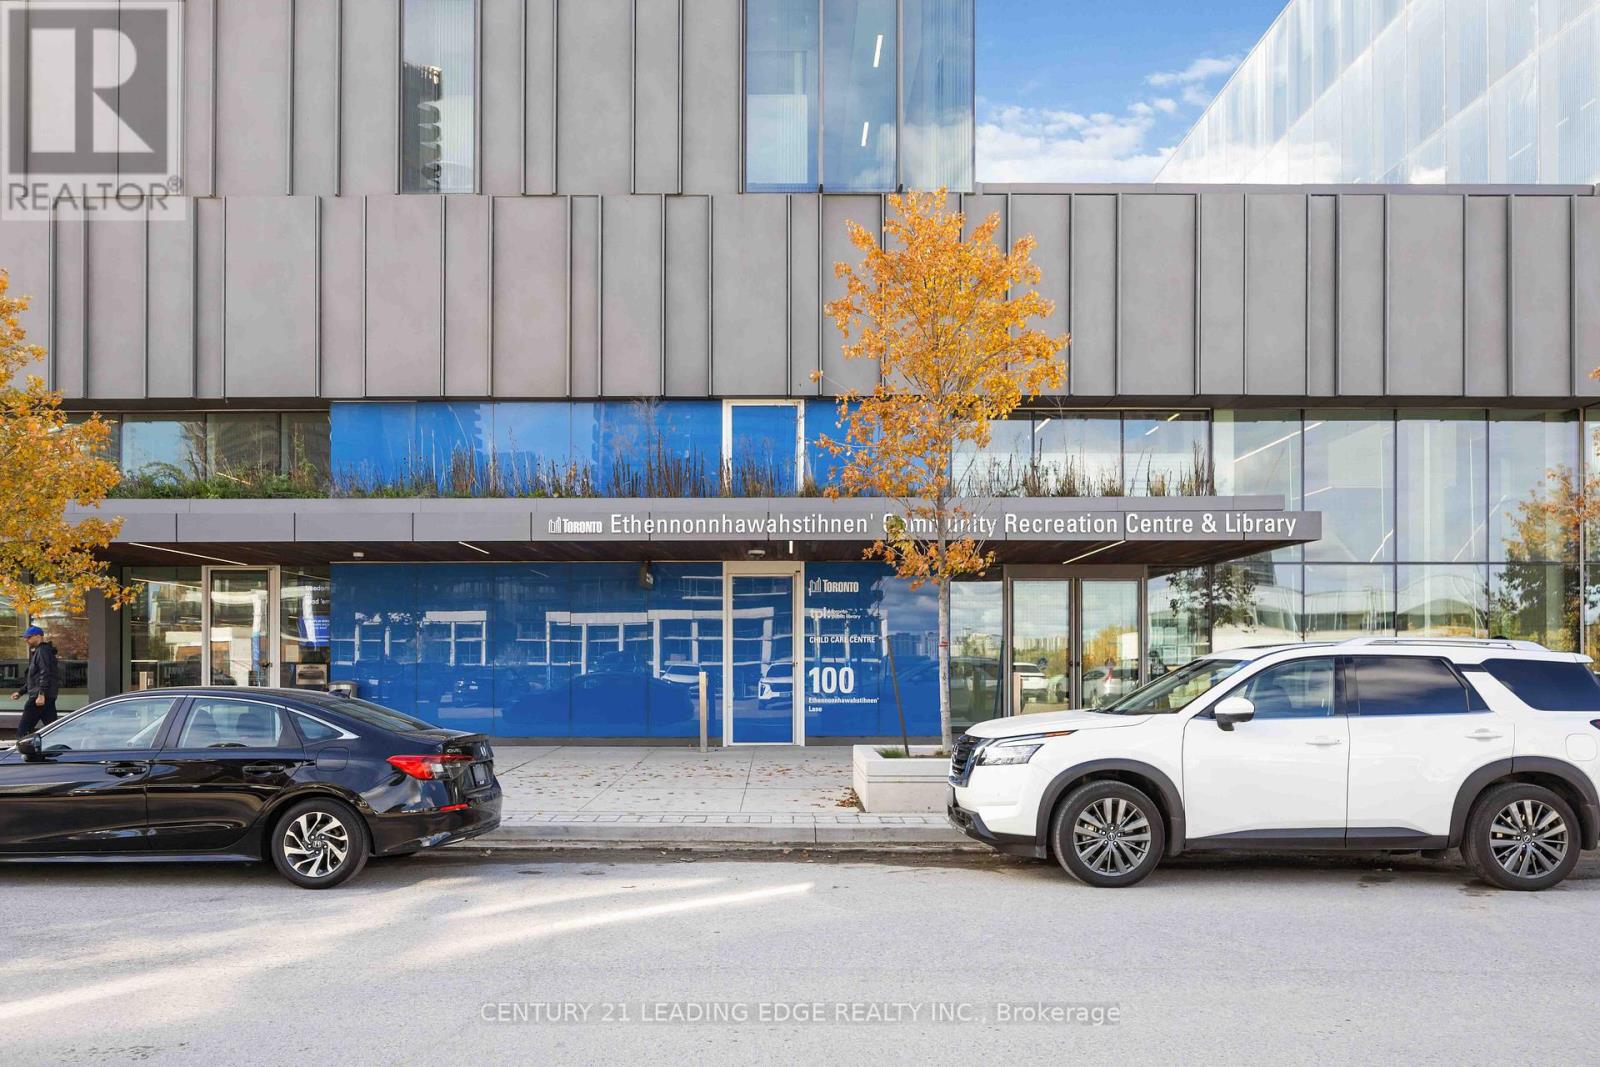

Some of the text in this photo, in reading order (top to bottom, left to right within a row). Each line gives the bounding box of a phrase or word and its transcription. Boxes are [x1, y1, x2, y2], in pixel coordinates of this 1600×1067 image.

[563, 518, 602, 533] TORONTO
[611, 513, 873, 534] Ethennonnhawahstihnen'
[1004, 512, 1118, 534] Recreation
[1126, 512, 1194, 534] Centre
[1201, 512, 1217, 534] &
[1225, 512, 1297, 537] Library
[823, 579, 859, 593] TORONTO
[808, 667, 855, 694] 100
